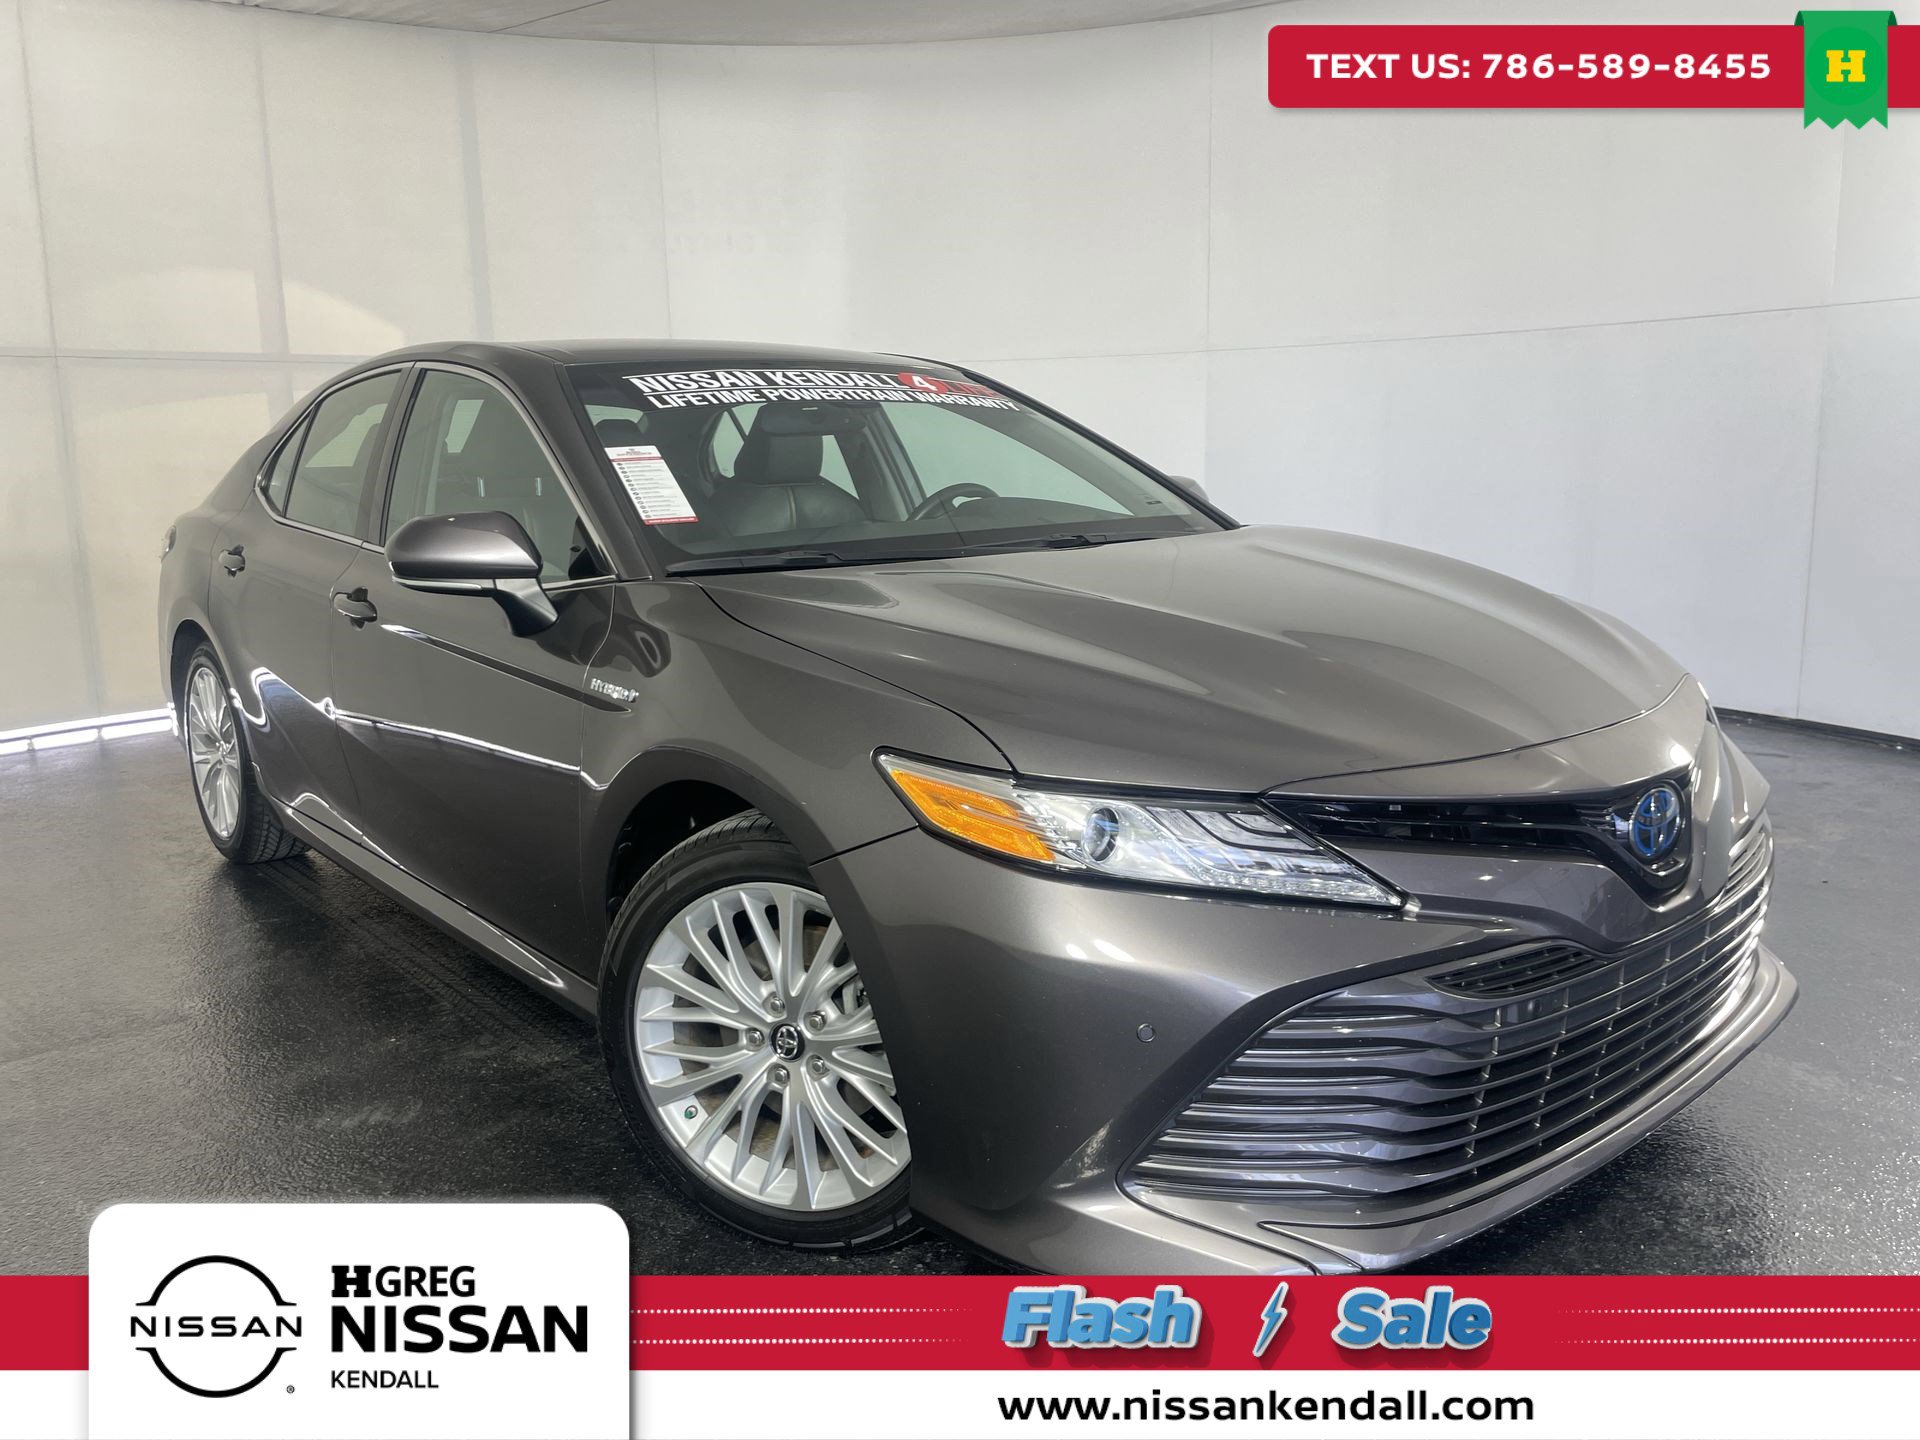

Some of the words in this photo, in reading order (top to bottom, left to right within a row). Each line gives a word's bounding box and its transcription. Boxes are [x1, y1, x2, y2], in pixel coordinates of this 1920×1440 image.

[629, 371, 769, 393] NISSAN
[763, 371, 911, 388] KENDALL
[911, 375, 938, 392] 4
[646, 389, 767, 408] LIFETIME
[760, 388, 910, 402] POWERTRAIN
[909, 391, 1020, 411] WARRANTY
